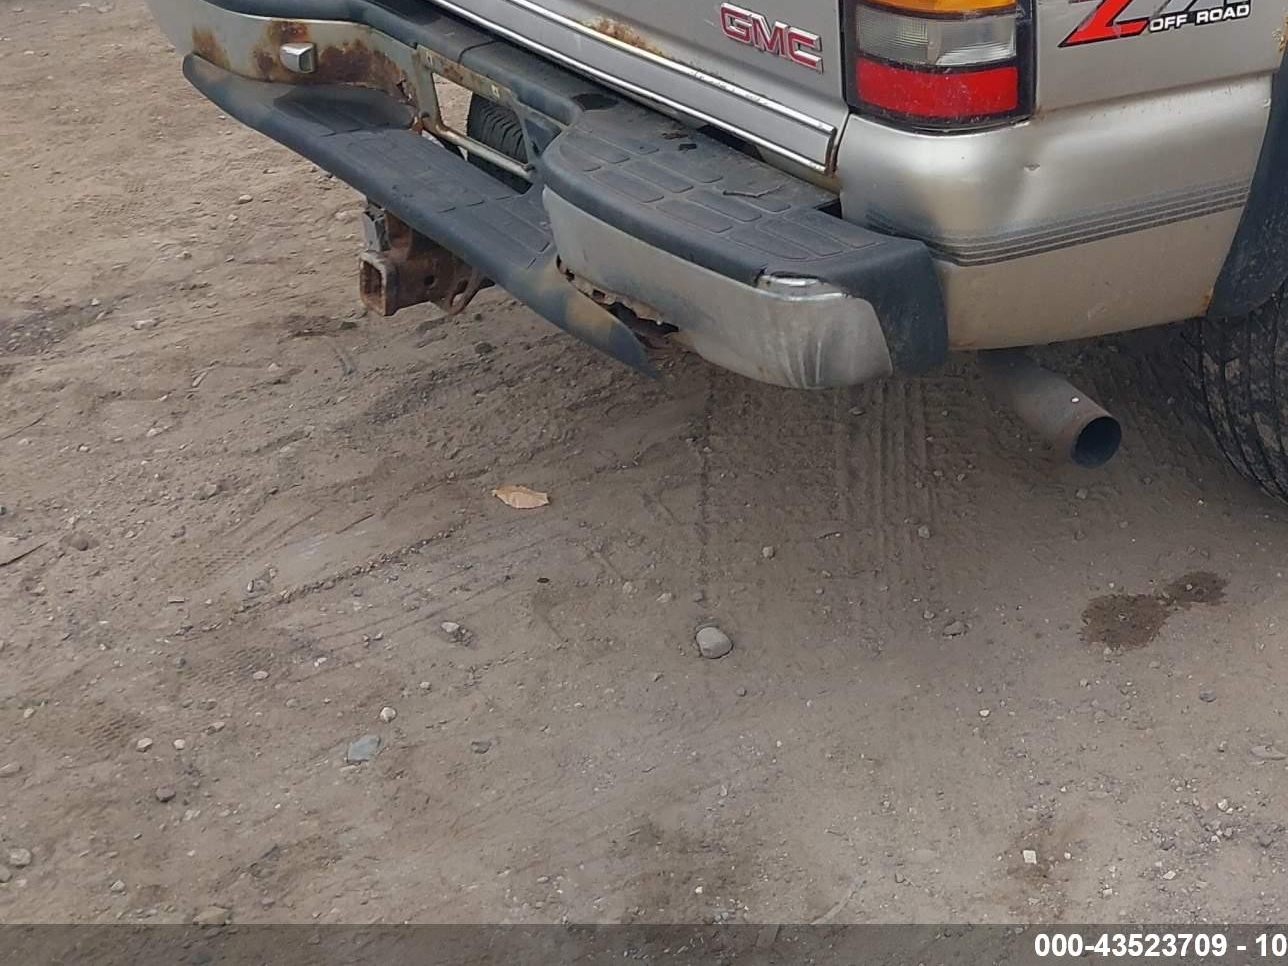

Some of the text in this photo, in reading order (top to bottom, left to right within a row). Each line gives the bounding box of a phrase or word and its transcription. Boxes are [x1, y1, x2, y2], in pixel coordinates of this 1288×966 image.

[720, 2, 824, 75] GMC
[1149, 4, 1250, 32] OFF ROAD
